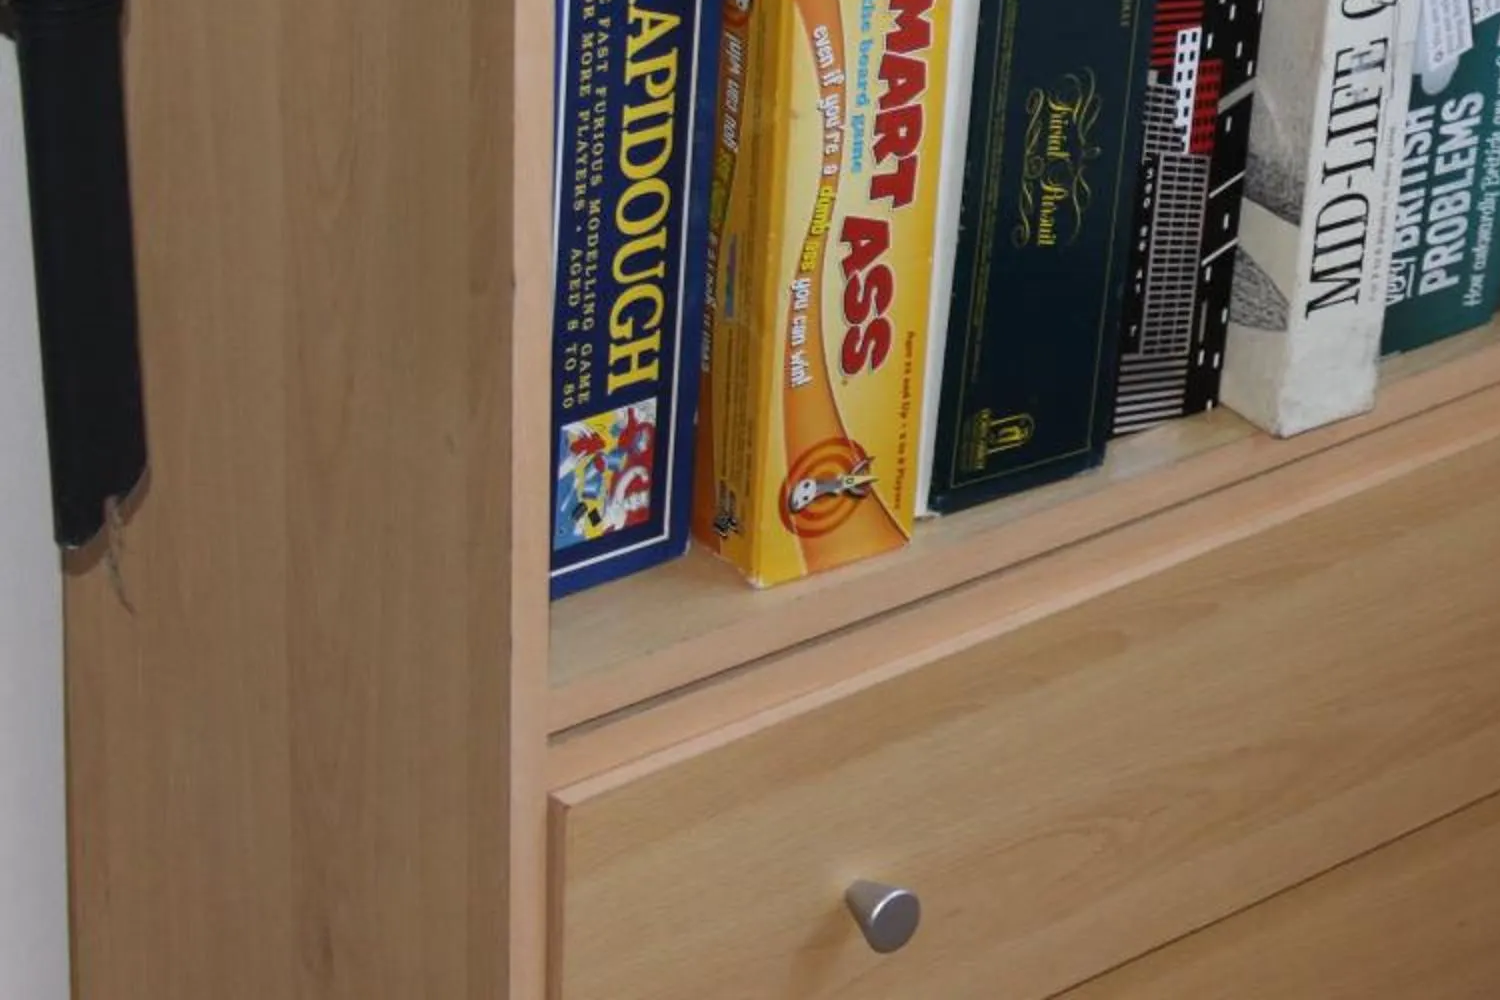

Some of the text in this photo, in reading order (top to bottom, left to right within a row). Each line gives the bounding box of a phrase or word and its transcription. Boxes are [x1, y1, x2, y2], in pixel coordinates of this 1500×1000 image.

[578, 31, 595, 99] MORE
[595, 17, 612, 73] FAST
[722, 32, 746, 154] you can win!
[855, 38, 874, 107] board
[571, 107, 592, 213] PLAYERS
[590, 86, 608, 187] FURIOUS
[850, 114, 866, 175] game
[1038, 95, 1077, 247] Trivial Pursuit
[1306, 37, 1388, 318] MID-LIFE
[1394, 104, 1437, 251] BRITISH
[790, 24, 846, 389] even if you're a dumb ass you can win!
[1418, 92, 1485, 295] PROBLEMS
[1470, 191, 1500, 272] awkwardly
[568, 248, 584, 306] AGED
[581, 198, 601, 332] MODELLING
[840, 215, 895, 376] ASS
[1462, 272, 1485, 307] How
[564, 341, 578, 373] TO
[577, 342, 593, 405] GAME
